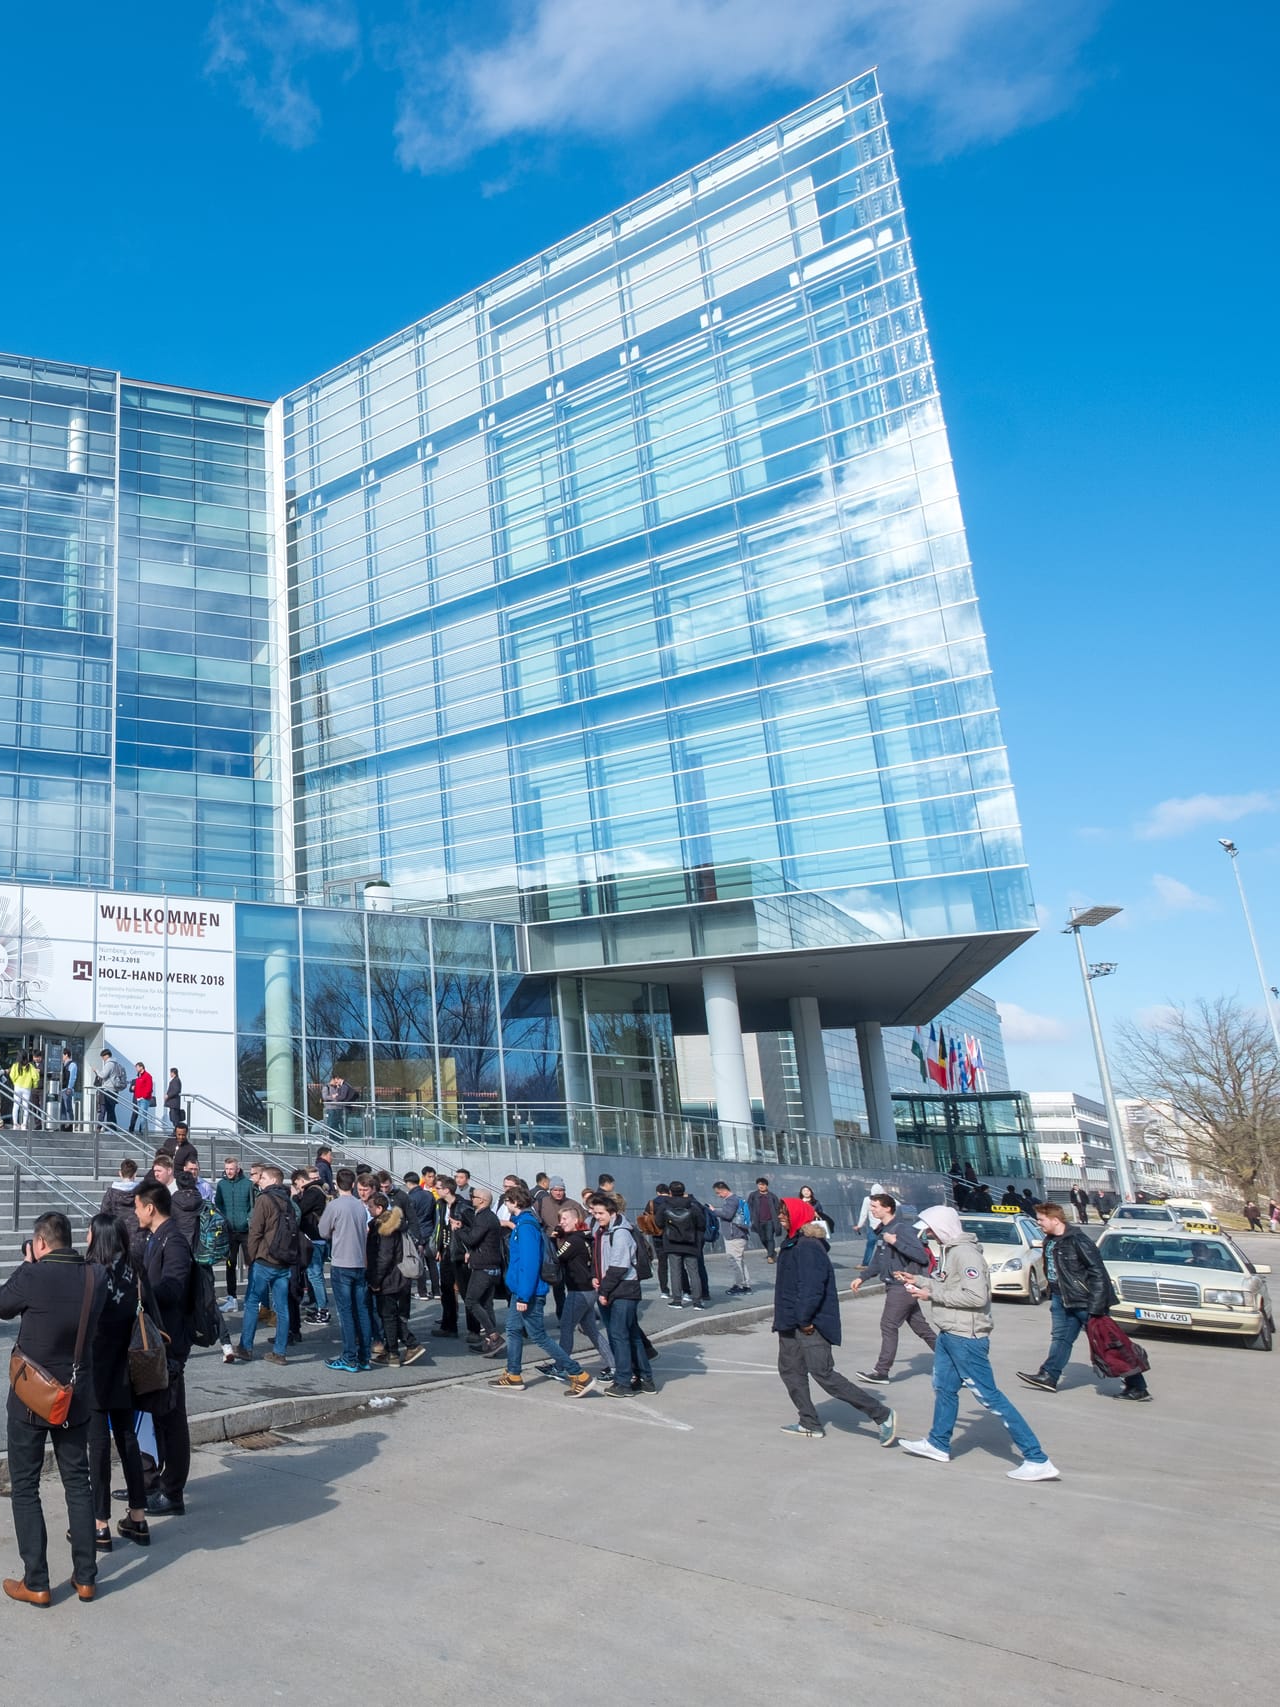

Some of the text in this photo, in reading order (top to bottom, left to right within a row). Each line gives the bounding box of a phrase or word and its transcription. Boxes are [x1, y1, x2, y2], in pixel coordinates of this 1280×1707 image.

[100, 904, 220, 927] WILLKOMMEN
[116, 918, 205, 938] WELCOME
[98, 967, 225, 986] HOLZ-HANDWERK 2018
